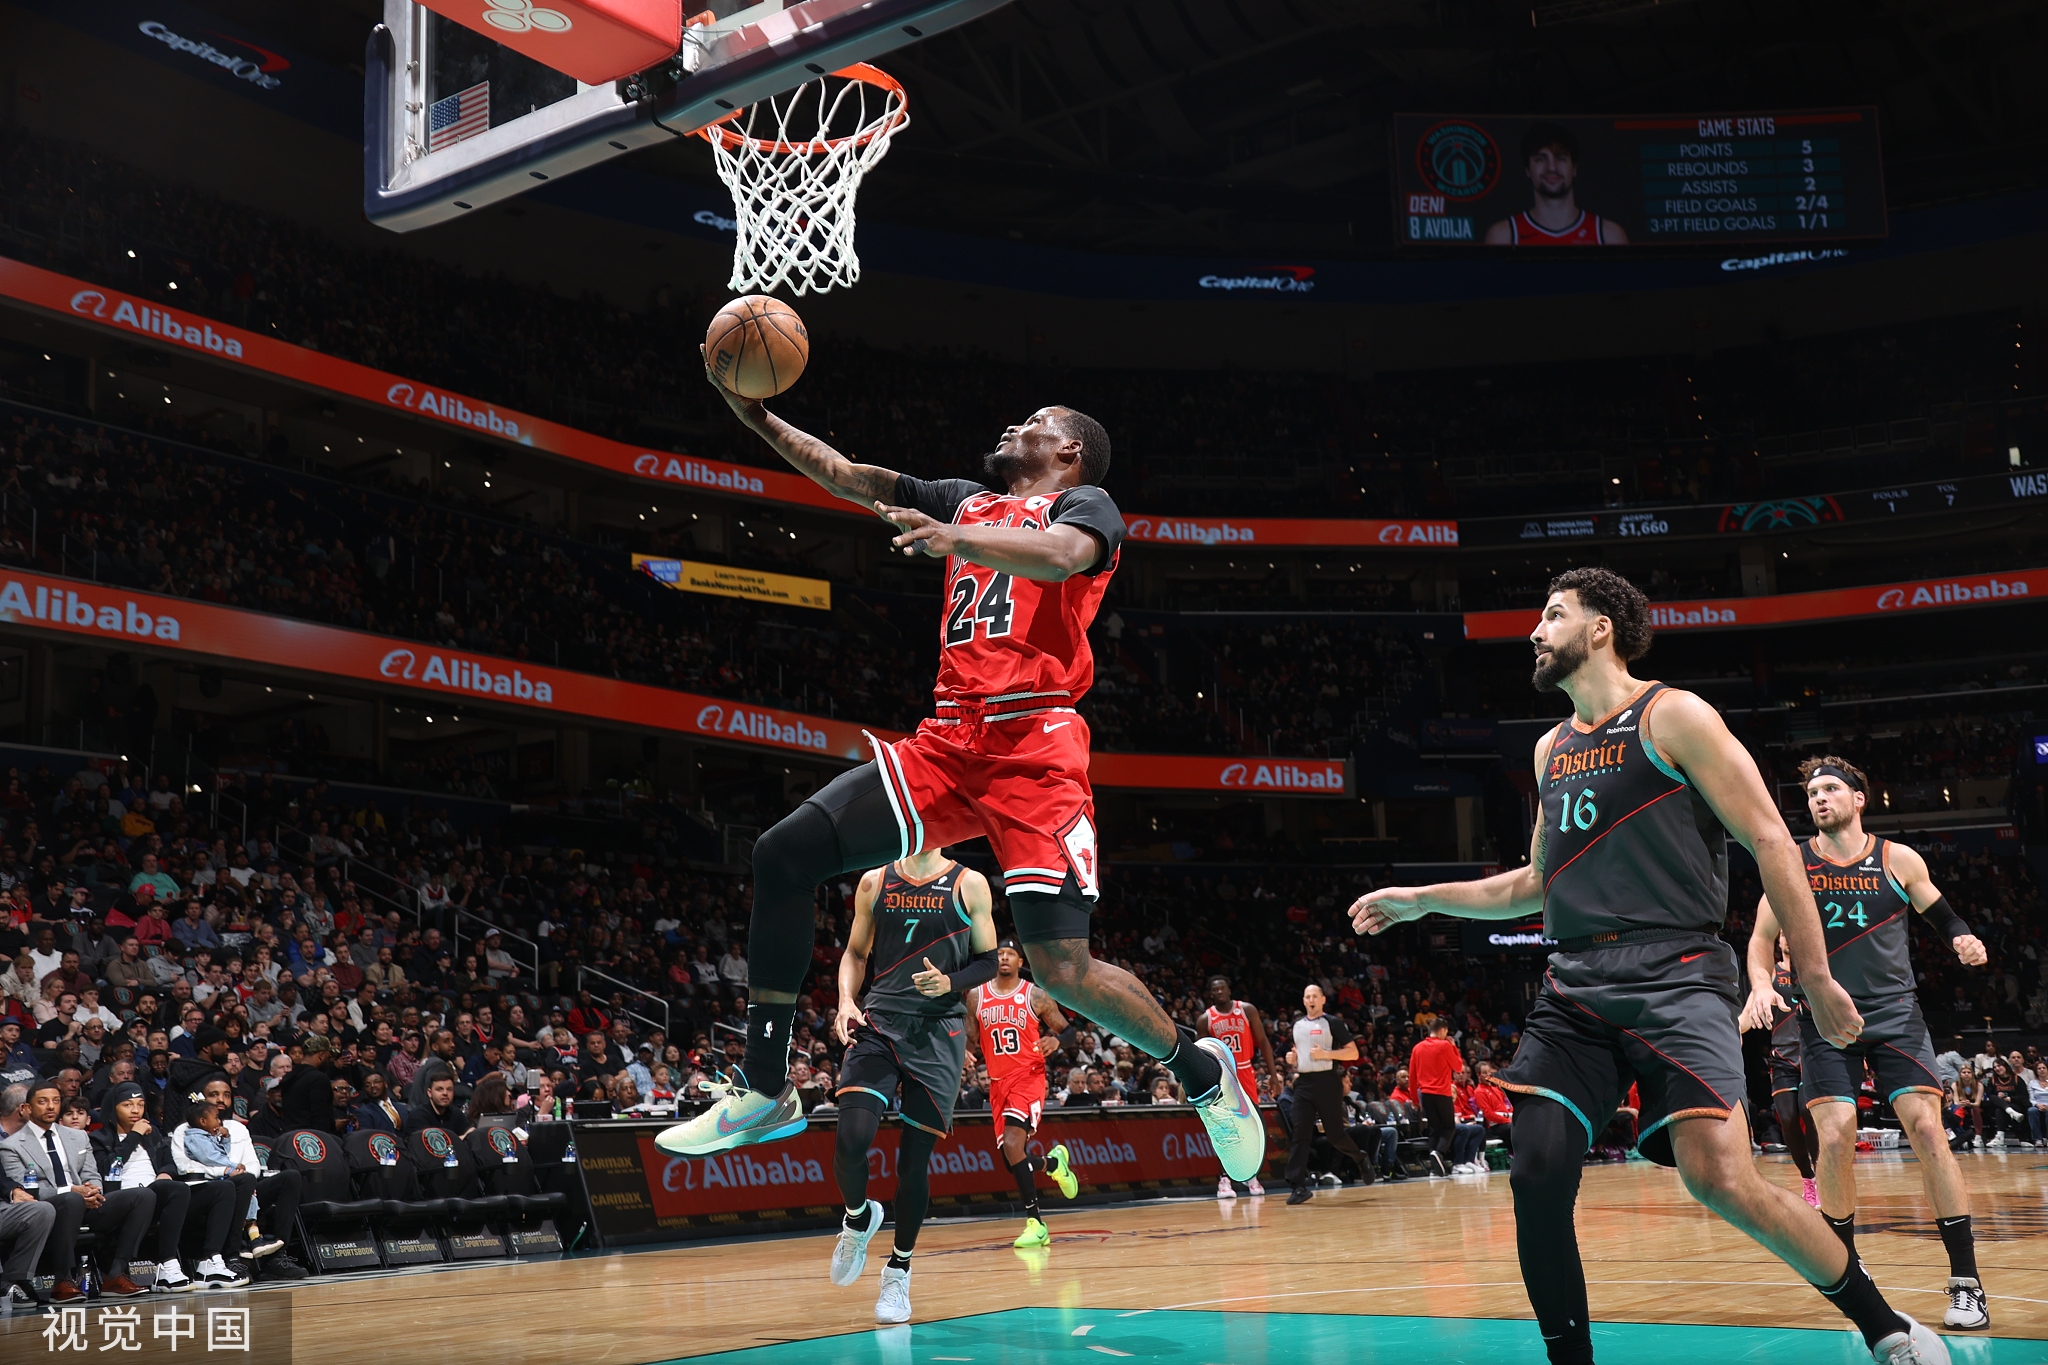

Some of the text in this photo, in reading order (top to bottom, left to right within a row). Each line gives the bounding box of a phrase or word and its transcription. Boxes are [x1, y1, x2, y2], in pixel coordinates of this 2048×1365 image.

[1426, 124, 1489, 147] WASHINGTON
[1698, 117, 1775, 137] GAME STATS
[1680, 139, 1812, 158] POINTS 5
[1667, 158, 1815, 177] REBOUNDS 3
[1436, 180, 1486, 197] WIZARDS
[1681, 176, 1817, 195] ASSISTS 2
[1409, 195, 1445, 214] DENI
[1665, 194, 1830, 214] FIELD GOALS 2/4
[1410, 217, 1421, 239] 8
[1650, 213, 1829, 233] 3-PT FIELD GOALS 1/1
[112, 300, 243, 359] Alibaba
[418, 389, 519, 439] Alibaba
[663, 458, 764, 494] Alibaba
[2009, 473, 2048, 498] WAS
[1872, 489, 1909, 501] FOULS
[1945, 494, 1955, 507] 7
[1888, 501, 1896, 514] 1
[1155, 521, 1255, 542] Alibaba
[1618, 519, 1669, 537] $1,660
[714, 570, 735, 580] Learn
[736, 574, 755, 583] more
[1910, 579, 2029, 606] Alibaba
[0, 581, 180, 642] Alibaba
[945, 570, 1014, 648] 24
[1650, 605, 1736, 627] libaba
[421, 655, 553, 703] Alibaba
[727, 709, 828, 750] Alibaba
[1606, 725, 1636, 735] Robinhood
[1550, 739, 1627, 781] District
[1565, 766, 1623, 783] COLUMBIA
[1559, 788, 1599, 833] 16
[1810, 872, 1880, 891] District
[885, 892, 945, 909] District
[1824, 900, 1869, 929] 24
[903, 919, 920, 943] 7
[981, 1005, 1027, 1030] BULLS
[1212, 1019, 1245, 1037] BULLS
[990, 1028, 1020, 1056] 13
[1222, 1034, 1242, 1053] 21
[703, 1152, 826, 1189] Alibaba
[399, 1243, 437, 1253] SPORTSBOOK
[464, 1239, 500, 1248] SPORTSBOOK
[523, 1234, 557, 1244] SPORTSBOOK
[335, 1247, 375, 1258] SPORTSBOOK
